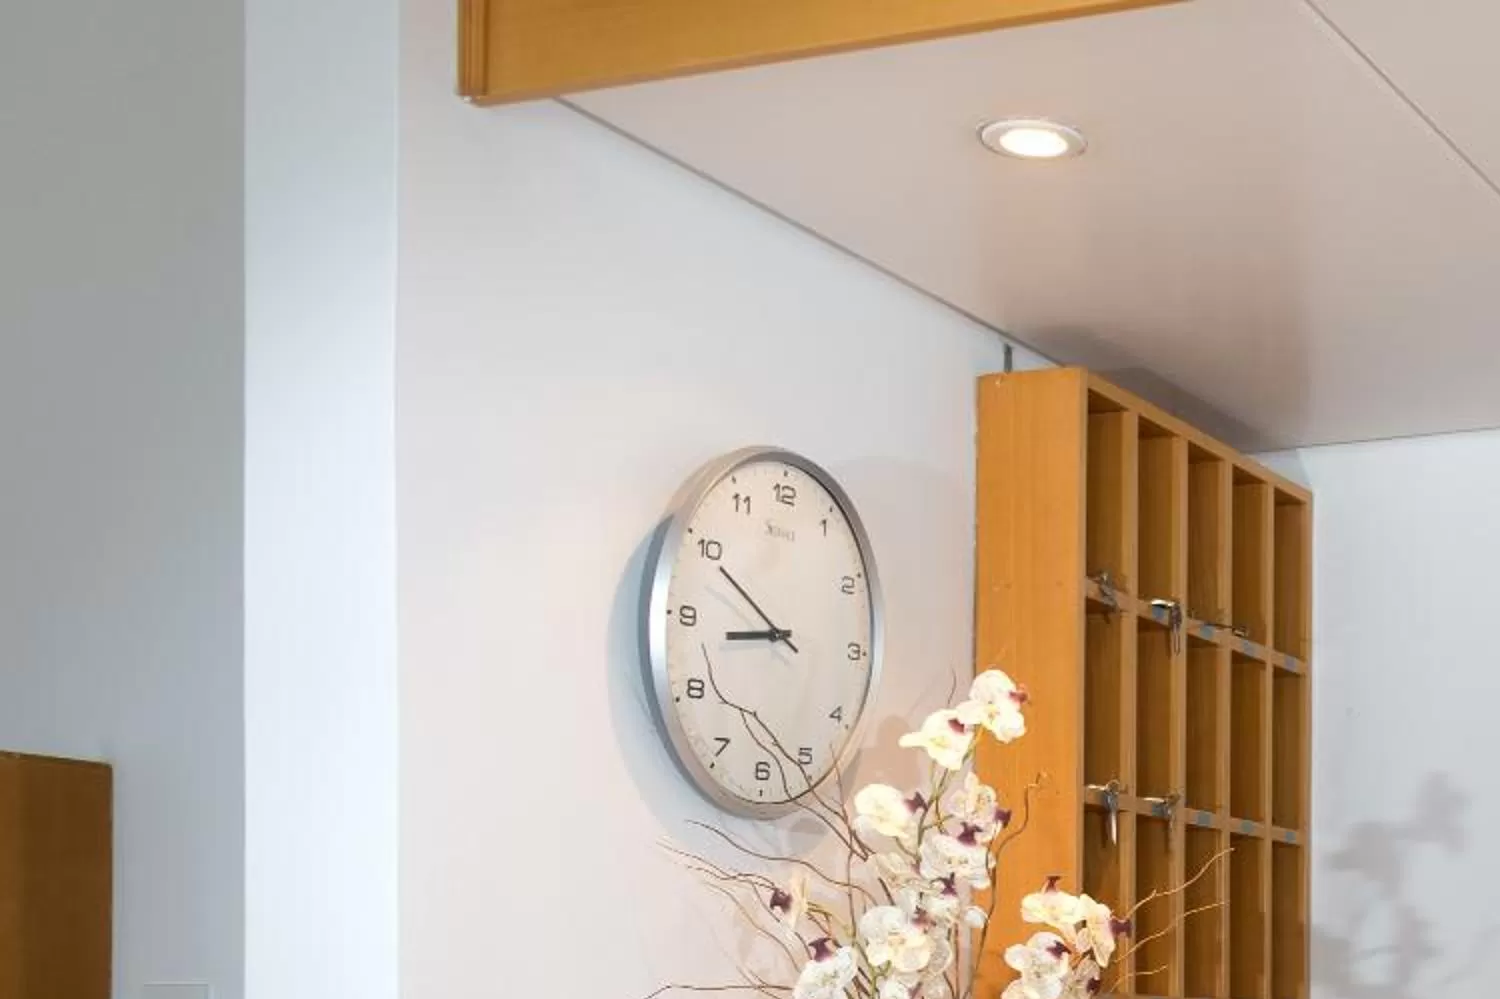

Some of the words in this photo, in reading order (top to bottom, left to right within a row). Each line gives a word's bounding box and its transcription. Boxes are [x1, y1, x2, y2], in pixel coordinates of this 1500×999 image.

[732, 493, 752, 515] 11
[772, 483, 797, 507] 12
[818, 518, 829, 538] 1
[697, 538, 723, 561] 10
[841, 575, 856, 595] 2
[679, 605, 697, 627] 9
[848, 642, 862, 661] 3
[687, 678, 705, 700] 8
[829, 705, 843, 725] 4
[713, 737, 731, 758] 7
[799, 747, 813, 766] 5
[755, 761, 771, 781] 6
